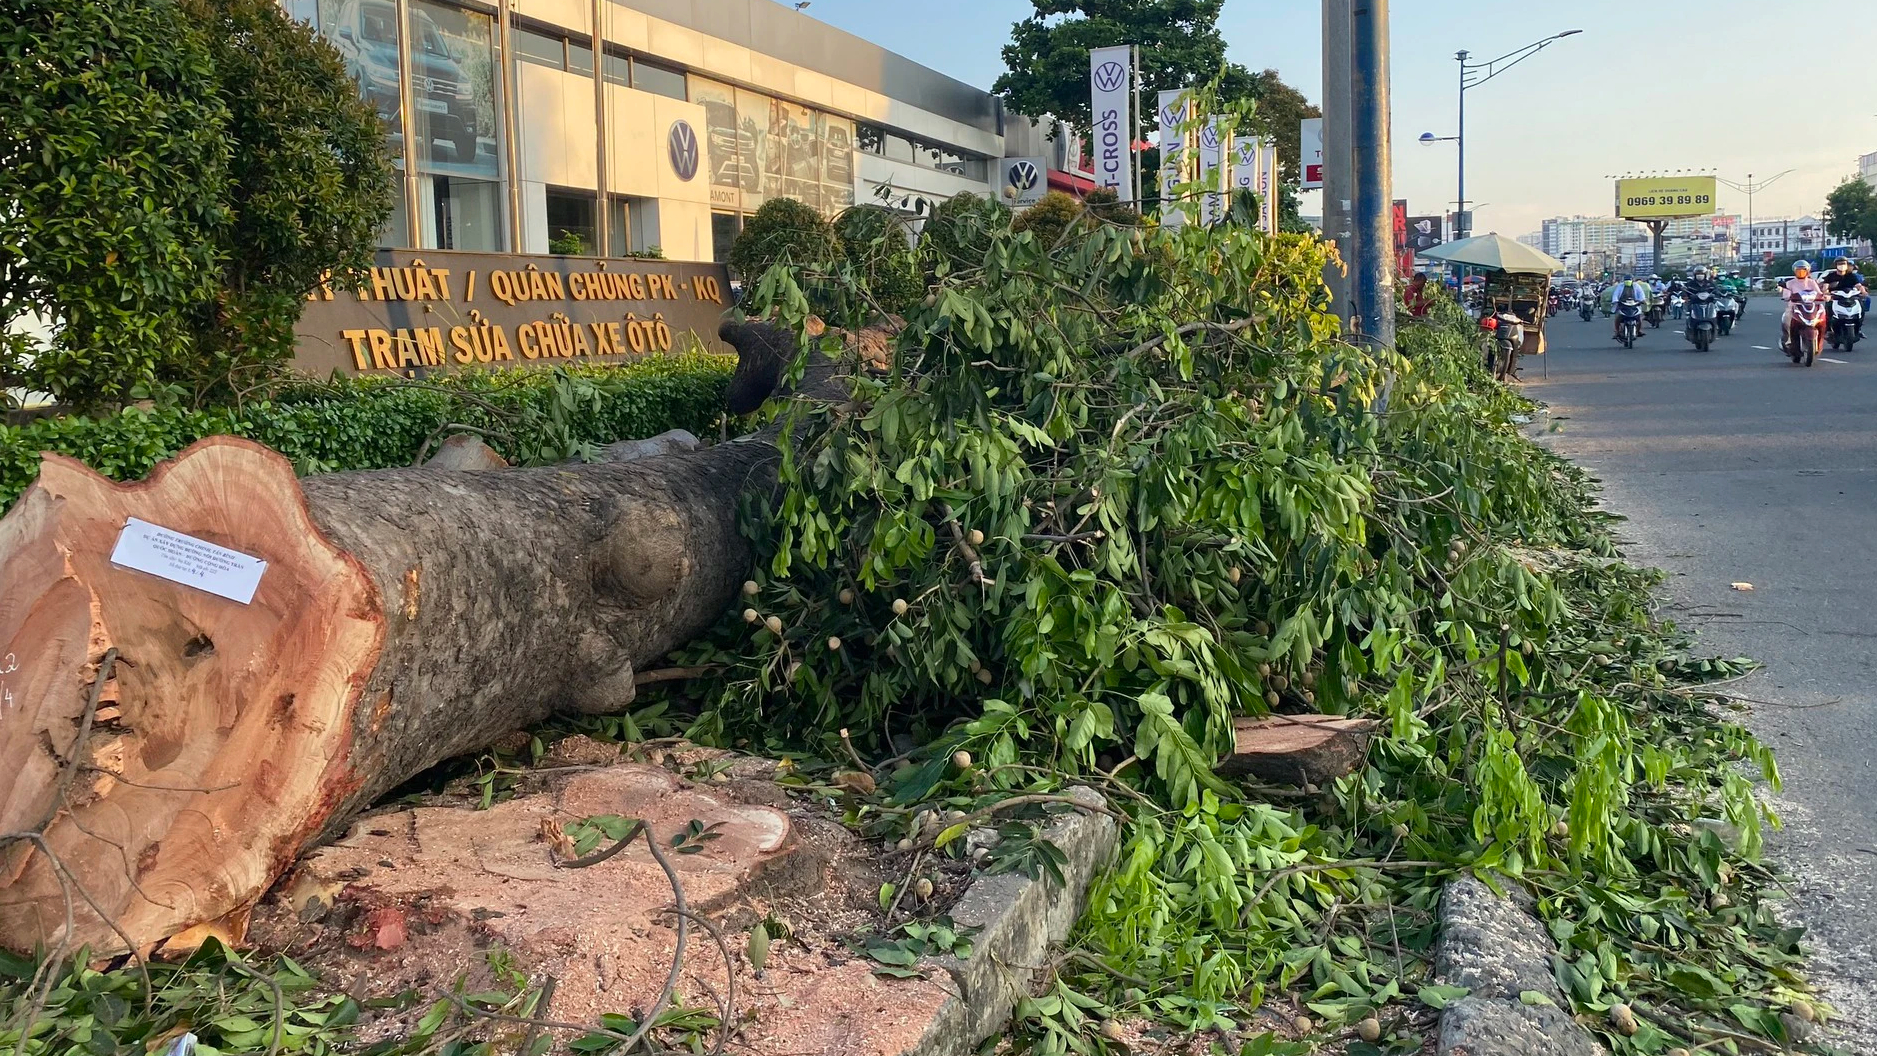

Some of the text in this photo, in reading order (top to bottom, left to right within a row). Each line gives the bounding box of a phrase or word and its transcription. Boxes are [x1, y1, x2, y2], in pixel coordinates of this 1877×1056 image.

[1102, 109, 1120, 188] T-CROSS
[490, 263, 566, 306] QUÂN
[568, 261, 646, 301] CHỦNG
[645, 274, 678, 299] PK
[691, 275, 722, 305] KQ
[342, 309, 672, 378] TRẠM SỬA CHỮA XE ÔTÔ
